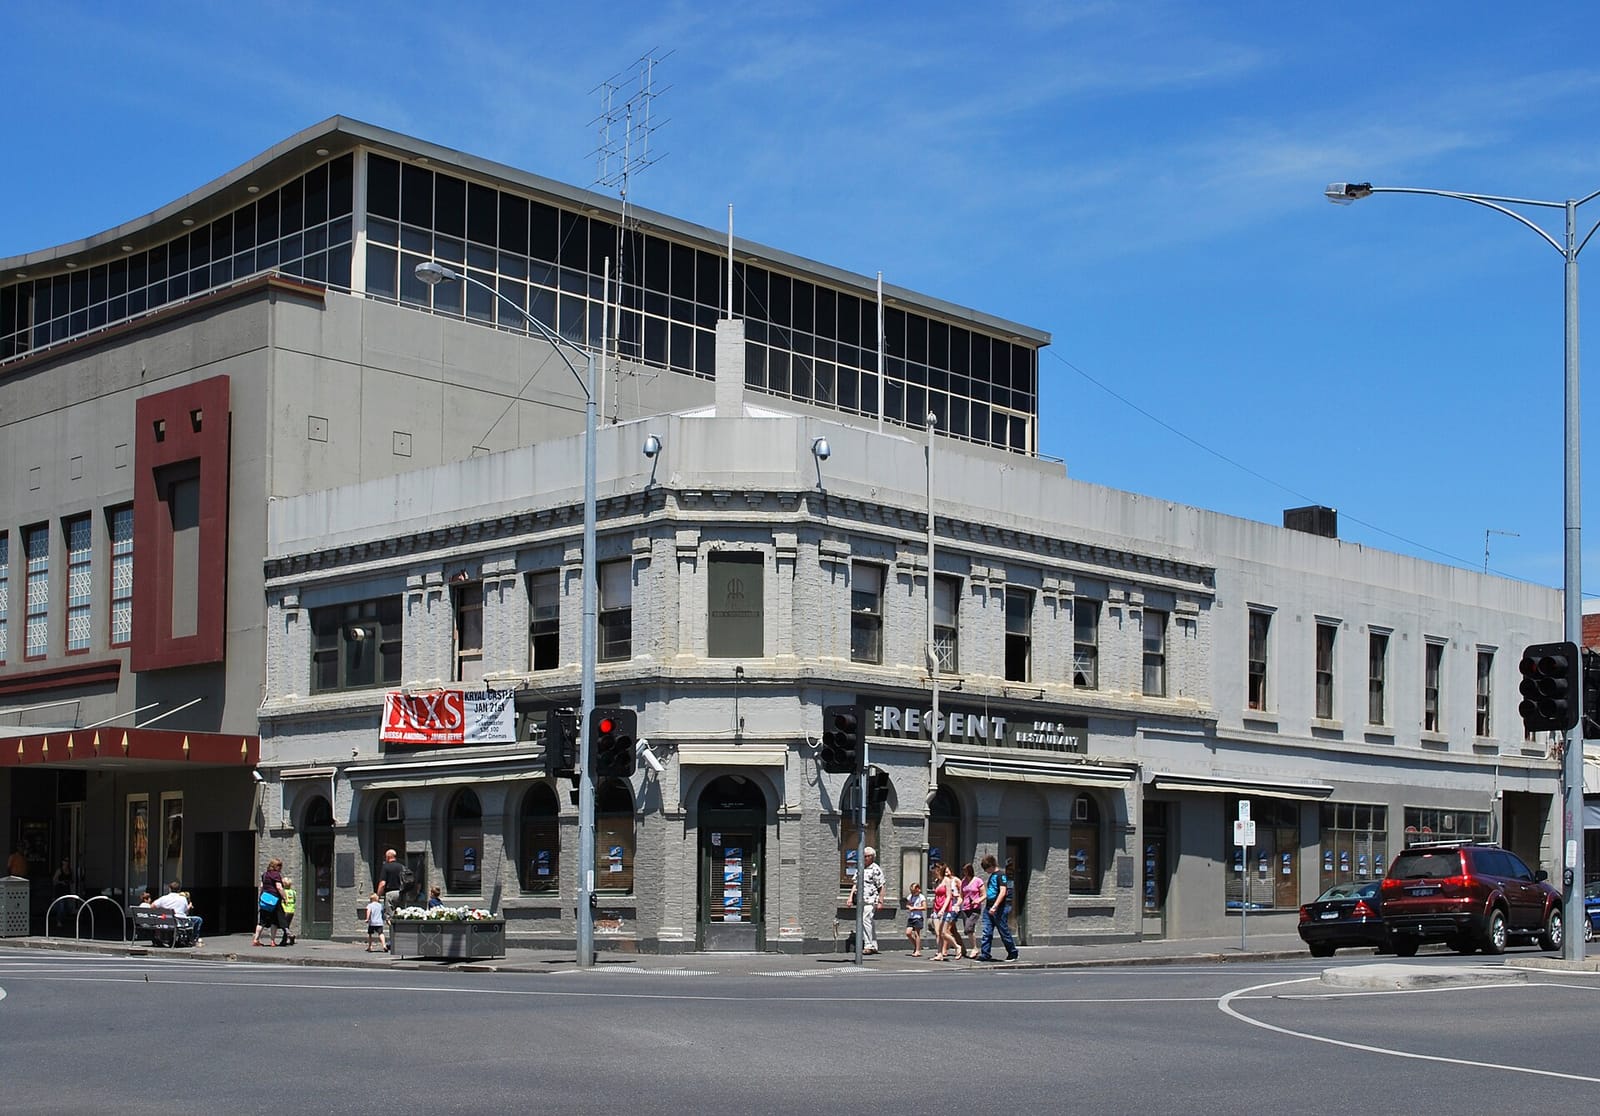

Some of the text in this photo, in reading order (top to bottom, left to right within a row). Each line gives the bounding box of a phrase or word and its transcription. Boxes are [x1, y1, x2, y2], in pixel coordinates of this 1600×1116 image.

[464, 691, 485, 701] KRYAL
[384, 692, 462, 730] INXS
[474, 703, 488, 713] JAN
[874, 706, 883, 729] THE
[882, 706, 1006, 740] REGENT
[1033, 721, 1065, 733] BAR &
[1015, 731, 1079, 746] RESTAURANT
